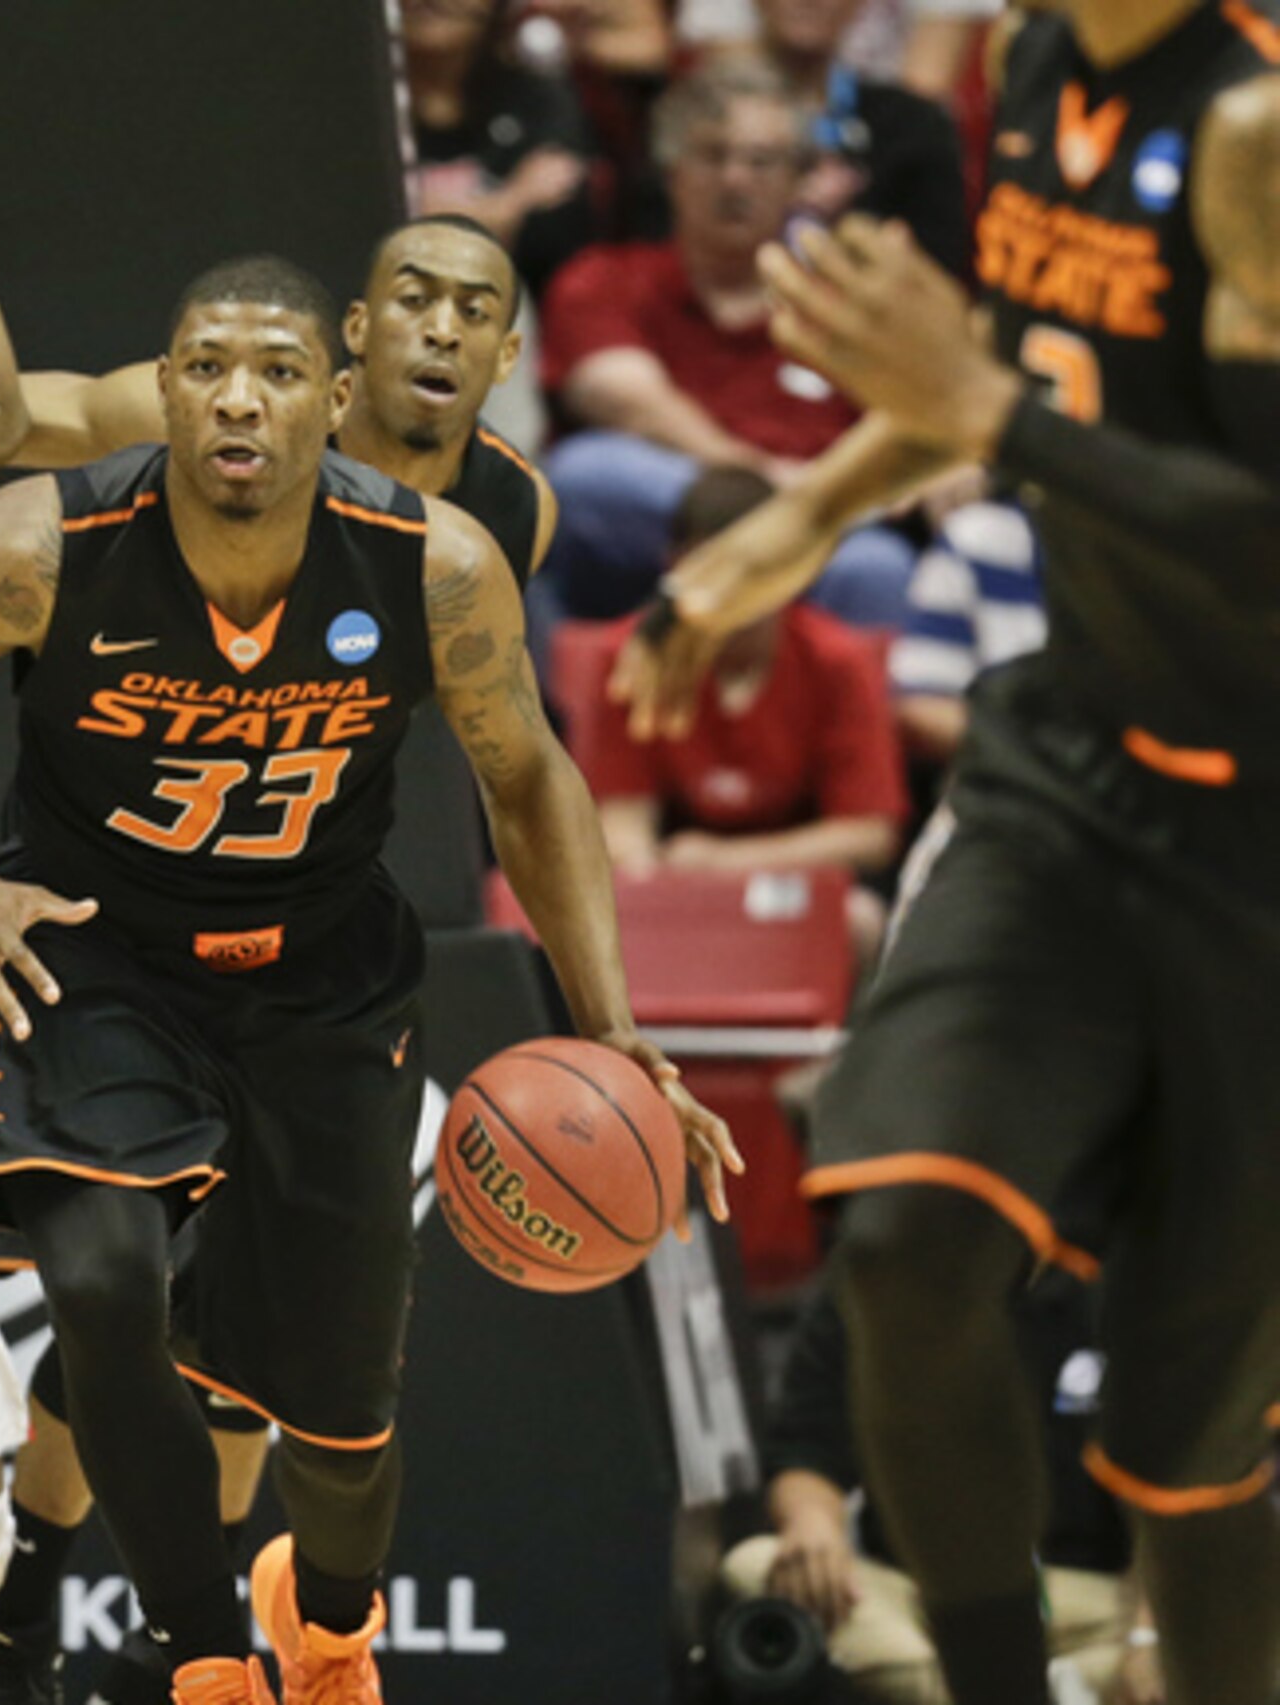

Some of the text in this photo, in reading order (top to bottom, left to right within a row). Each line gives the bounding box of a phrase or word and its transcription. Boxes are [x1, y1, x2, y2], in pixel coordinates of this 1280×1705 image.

[75, 688, 392, 749] STATE
[120, 671, 368, 709] OKLAHOMA
[104, 748, 353, 860] 33
[455, 1112, 581, 1261] Wilson
